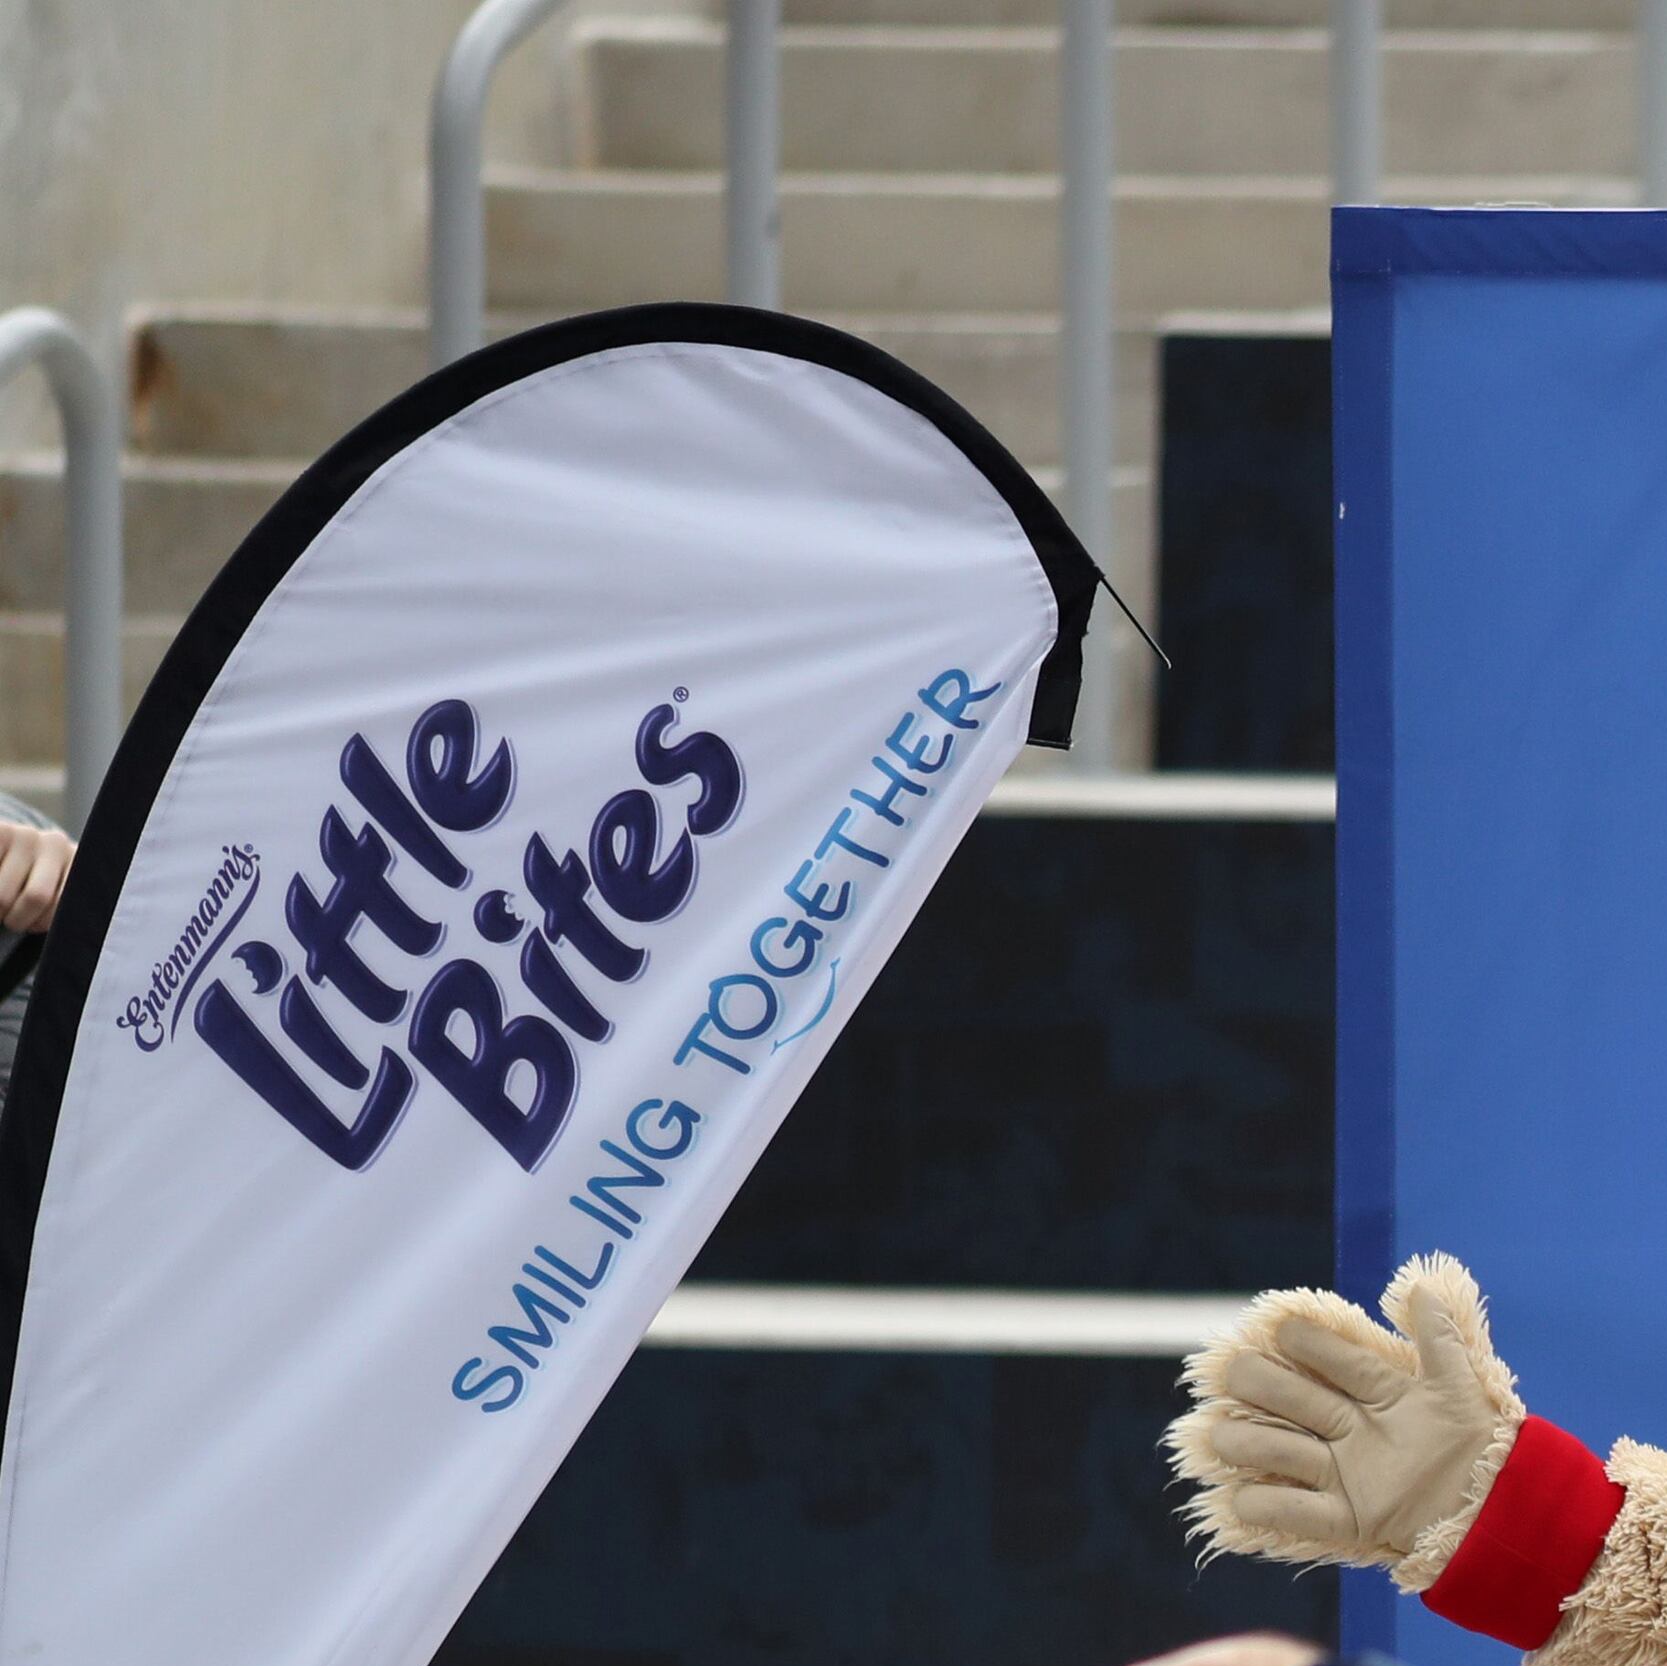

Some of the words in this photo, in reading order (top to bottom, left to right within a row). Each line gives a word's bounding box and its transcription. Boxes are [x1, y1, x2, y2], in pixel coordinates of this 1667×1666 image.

[115, 843, 261, 1053] Entenmann's
[193, 698, 516, 1173] Little
[451, 1096, 702, 1413] SMILING
[672, 667, 1003, 1077] TOGETHER
